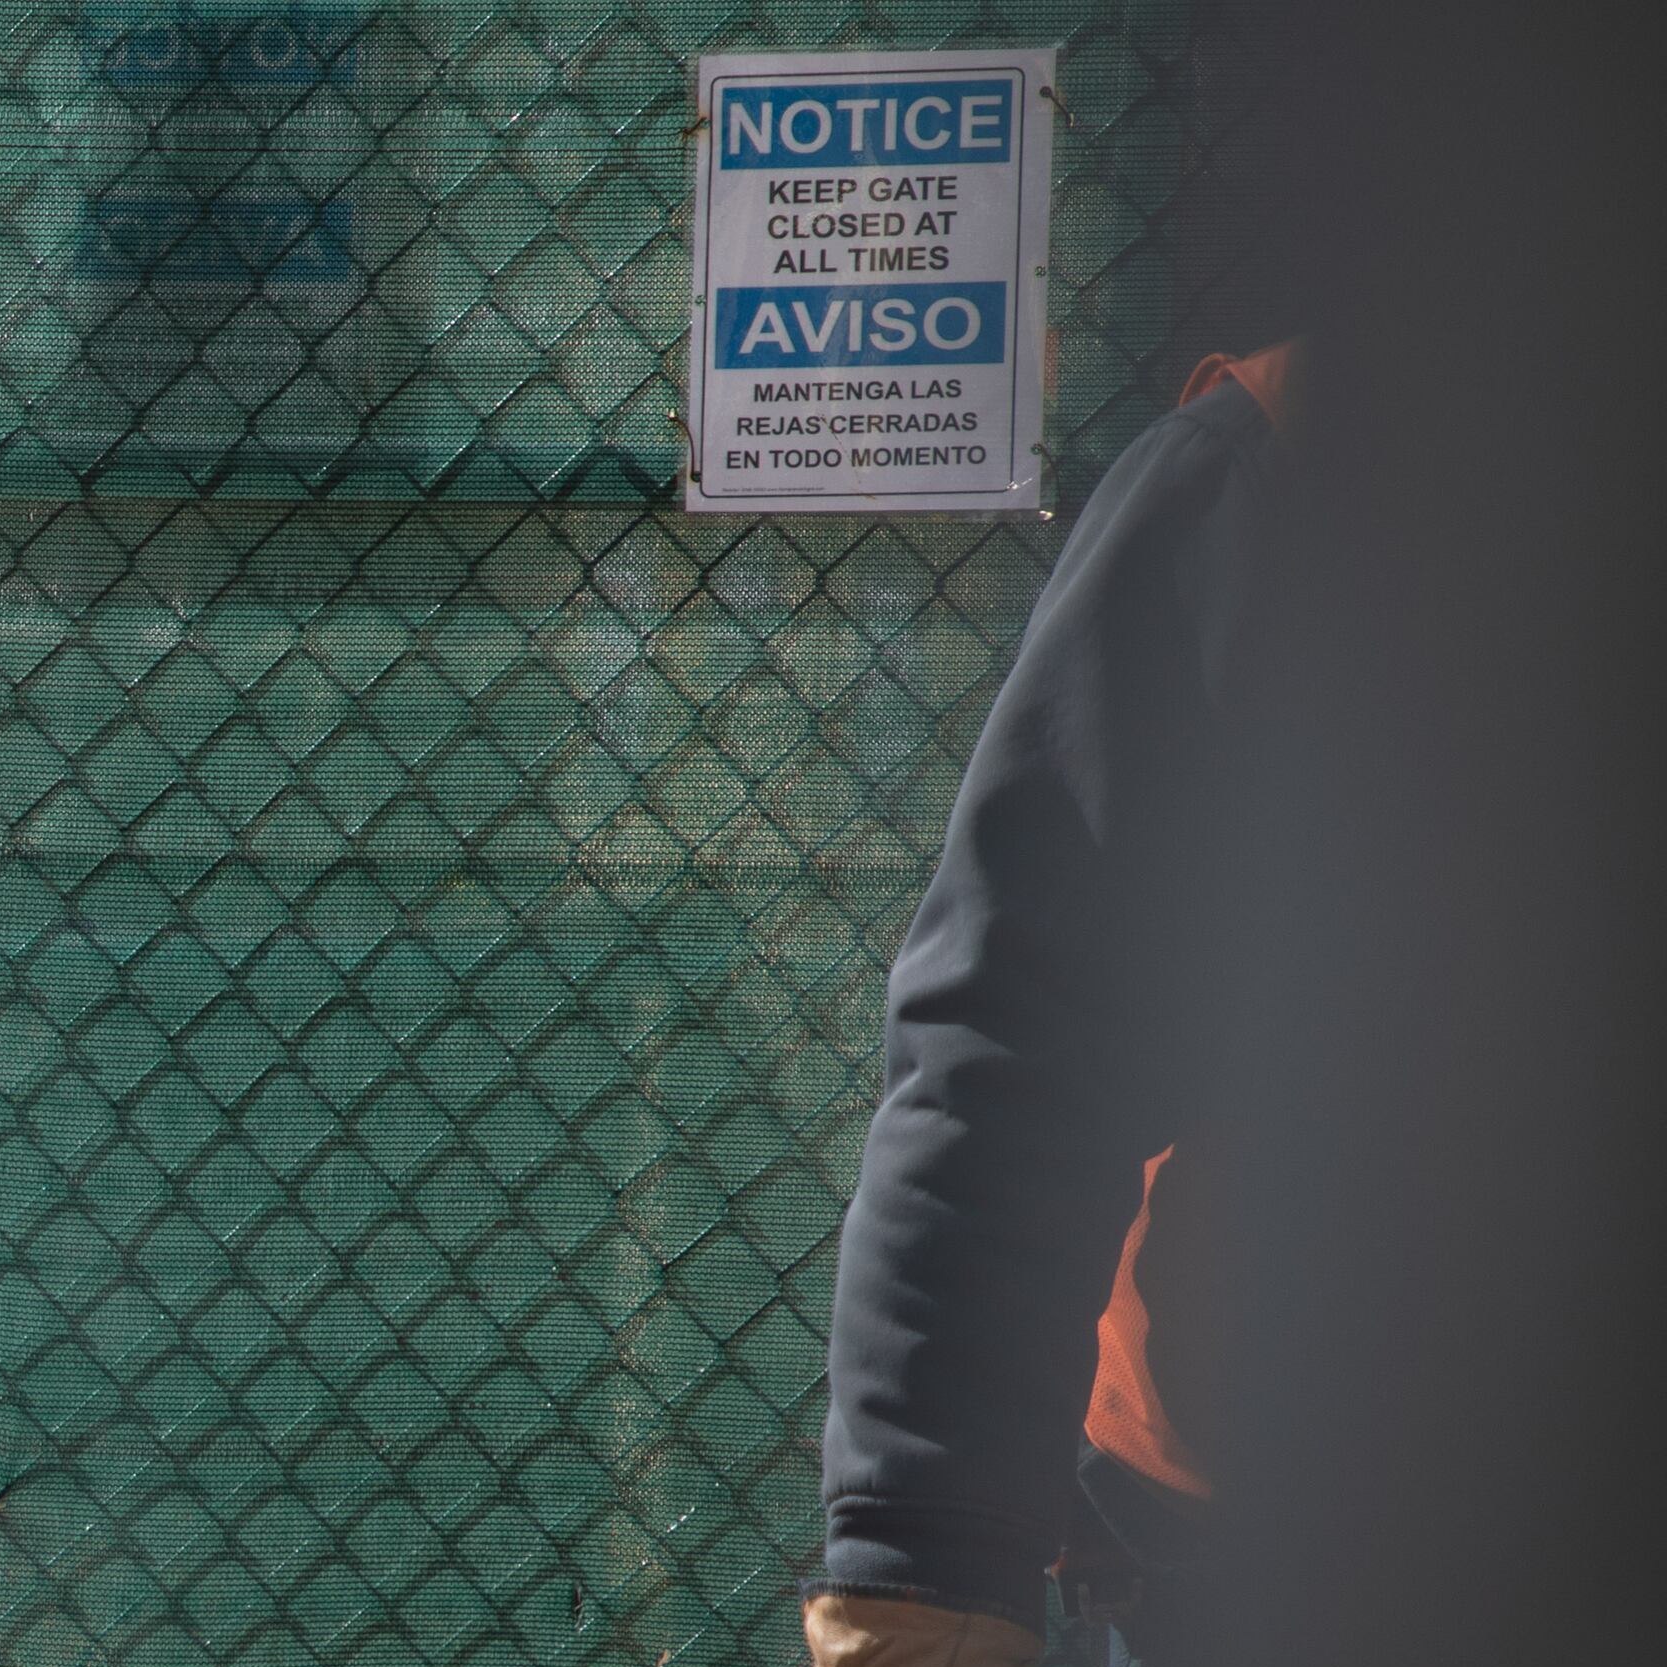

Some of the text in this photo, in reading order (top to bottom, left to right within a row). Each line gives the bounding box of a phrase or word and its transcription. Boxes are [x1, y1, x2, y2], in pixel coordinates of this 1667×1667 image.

[728, 96, 1003, 155] NOTICE
[768, 176, 957, 205] KEEP GATE
[767, 211, 957, 239] CLOSED AT
[773, 246, 950, 273] ALL TIMES
[738, 297, 981, 355] AVISO
[753, 379, 962, 403] MANTENGA LAS
[736, 411, 978, 437] REJAS CERRADAS
[726, 445, 987, 470] EN TODO MOMENTO
